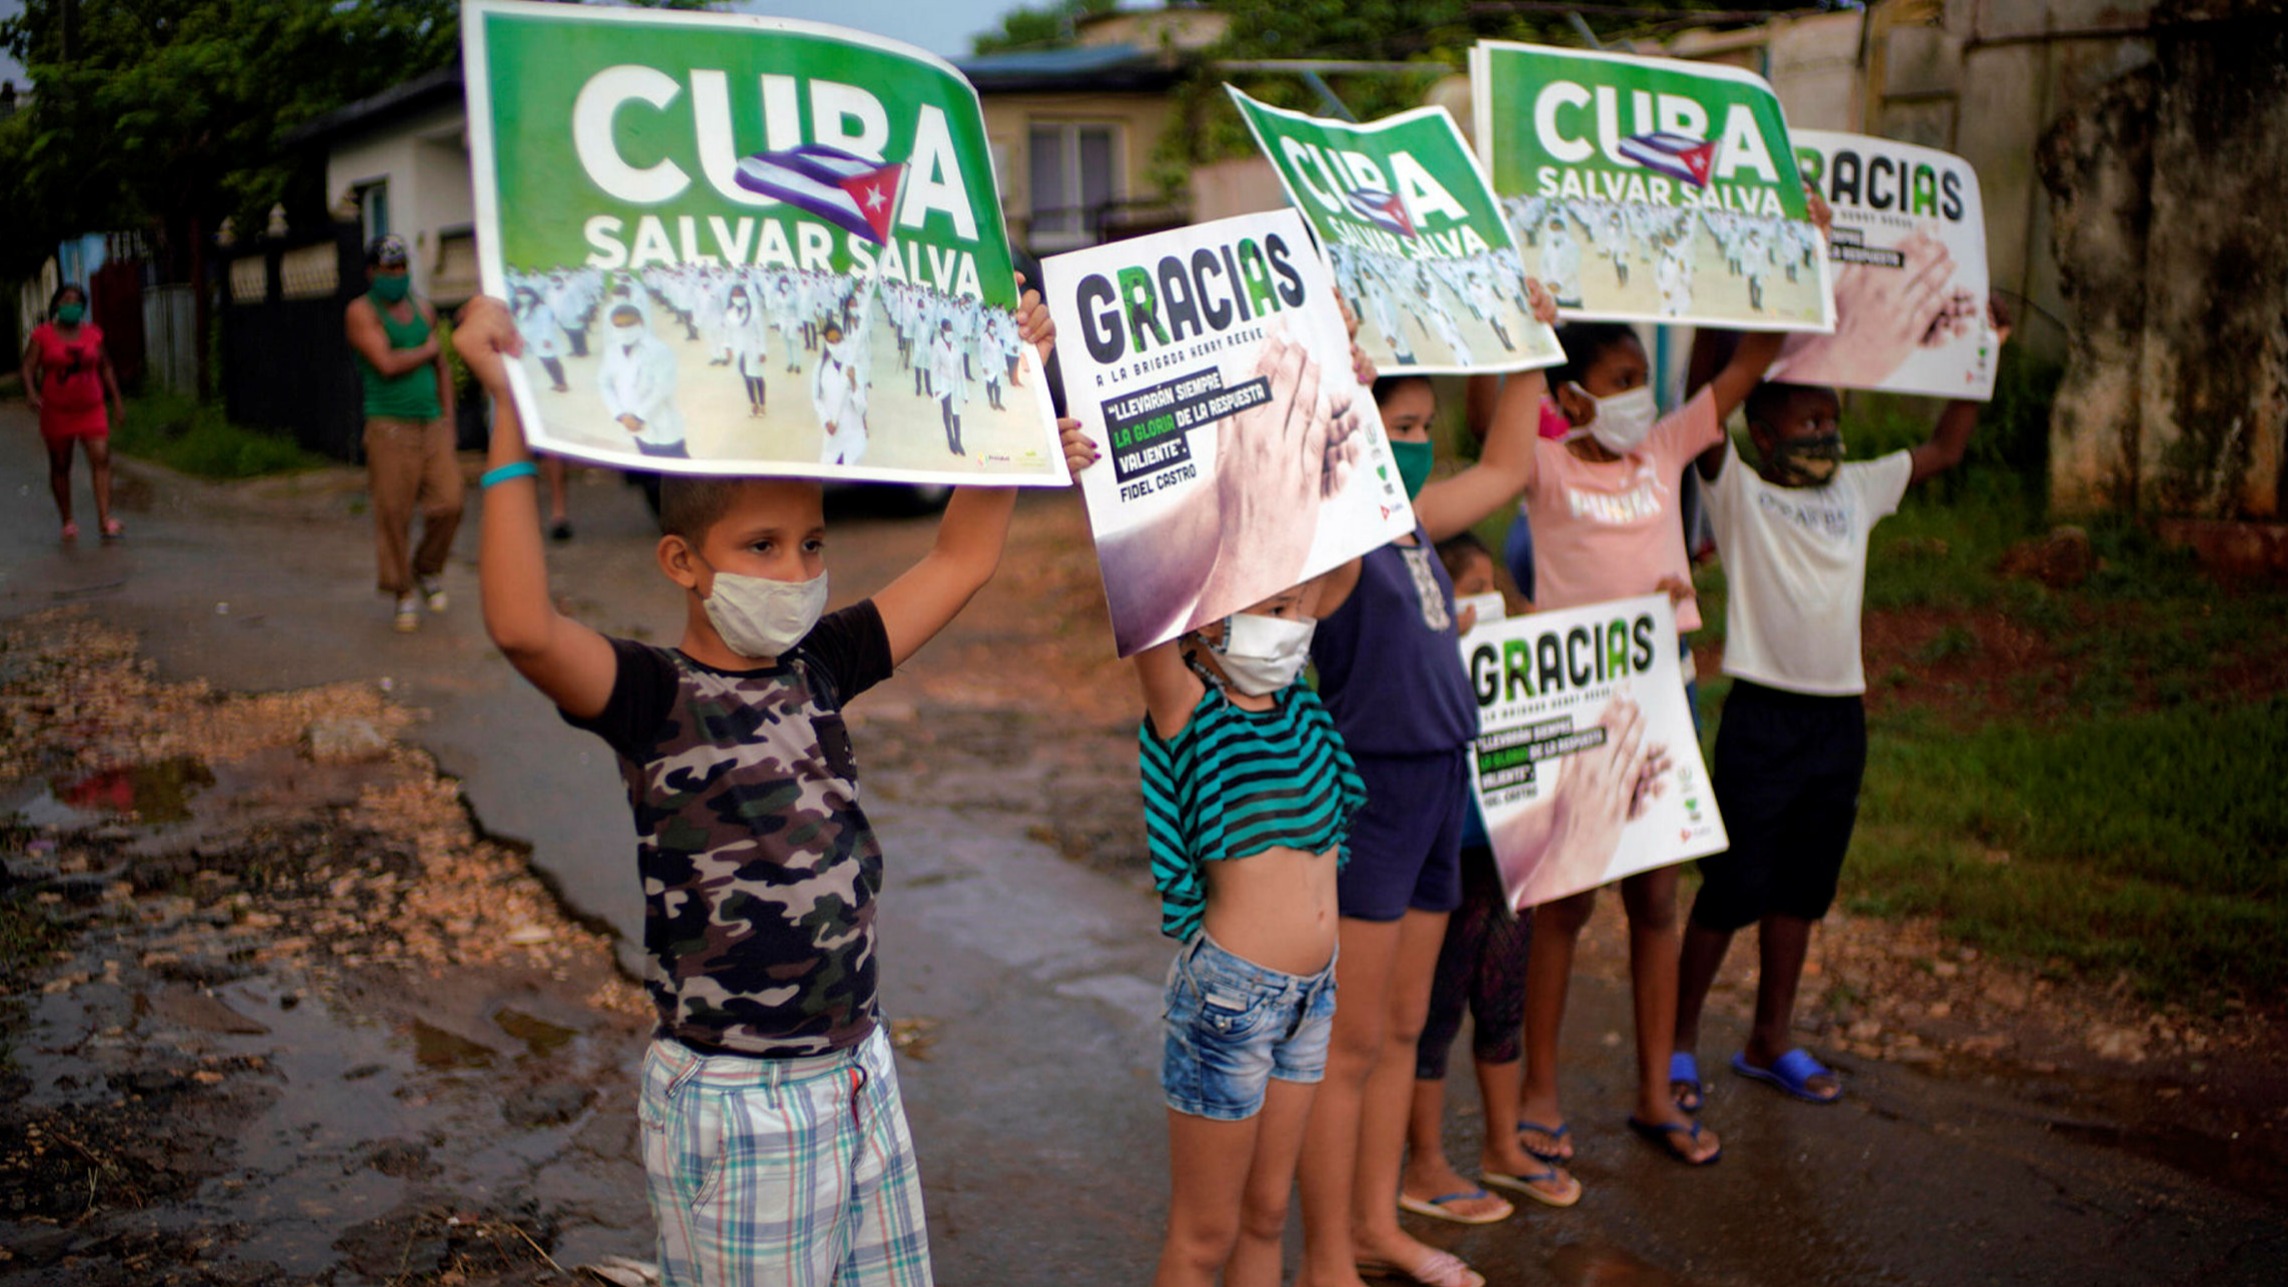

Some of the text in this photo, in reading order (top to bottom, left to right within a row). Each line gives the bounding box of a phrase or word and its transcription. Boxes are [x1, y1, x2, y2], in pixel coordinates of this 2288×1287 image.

[572, 64, 979, 242] CUBA
[1534, 80, 1780, 183] CUBA
[1280, 136, 1469, 228] CUBA
[1537, 167, 1785, 220] SALVAR SALVA
[1794, 147, 1964, 222] RACIAS
[583, 215, 984, 302] SALVAR SALVA
[1404, 224, 1491, 260] SALVA
[1076, 232, 1306, 365] GRACIAS
[1096, 327, 1264, 387] A LA BRIGADA HENRY REEVE
[1175, 372, 1222, 401] SIEMPRE
[1114, 383, 1266, 448] LA GLORIA DE LA RESPUESTA
[1120, 463, 1197, 502] FIDEL CASTRO
[1470, 611, 1655, 707] GRACIAS
